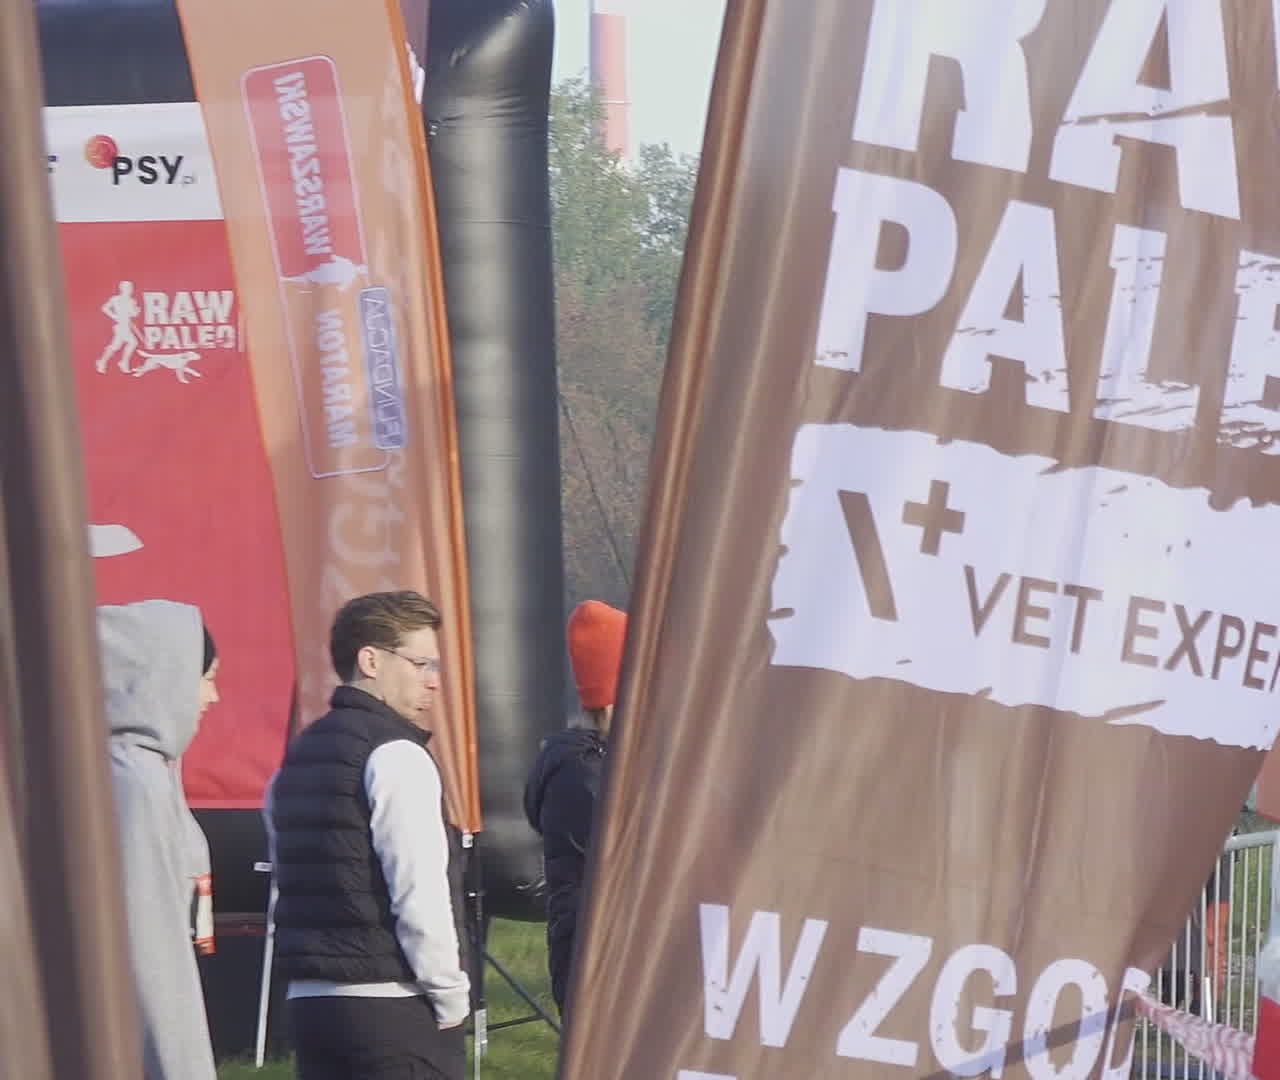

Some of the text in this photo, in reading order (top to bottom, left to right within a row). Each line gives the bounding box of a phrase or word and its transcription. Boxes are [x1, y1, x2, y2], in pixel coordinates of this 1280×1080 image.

[144, 291, 234, 324] RAW
[144, 326, 236, 350] PALEO
[964, 565, 1104, 655] VET
[700, 903, 828, 1048] W
